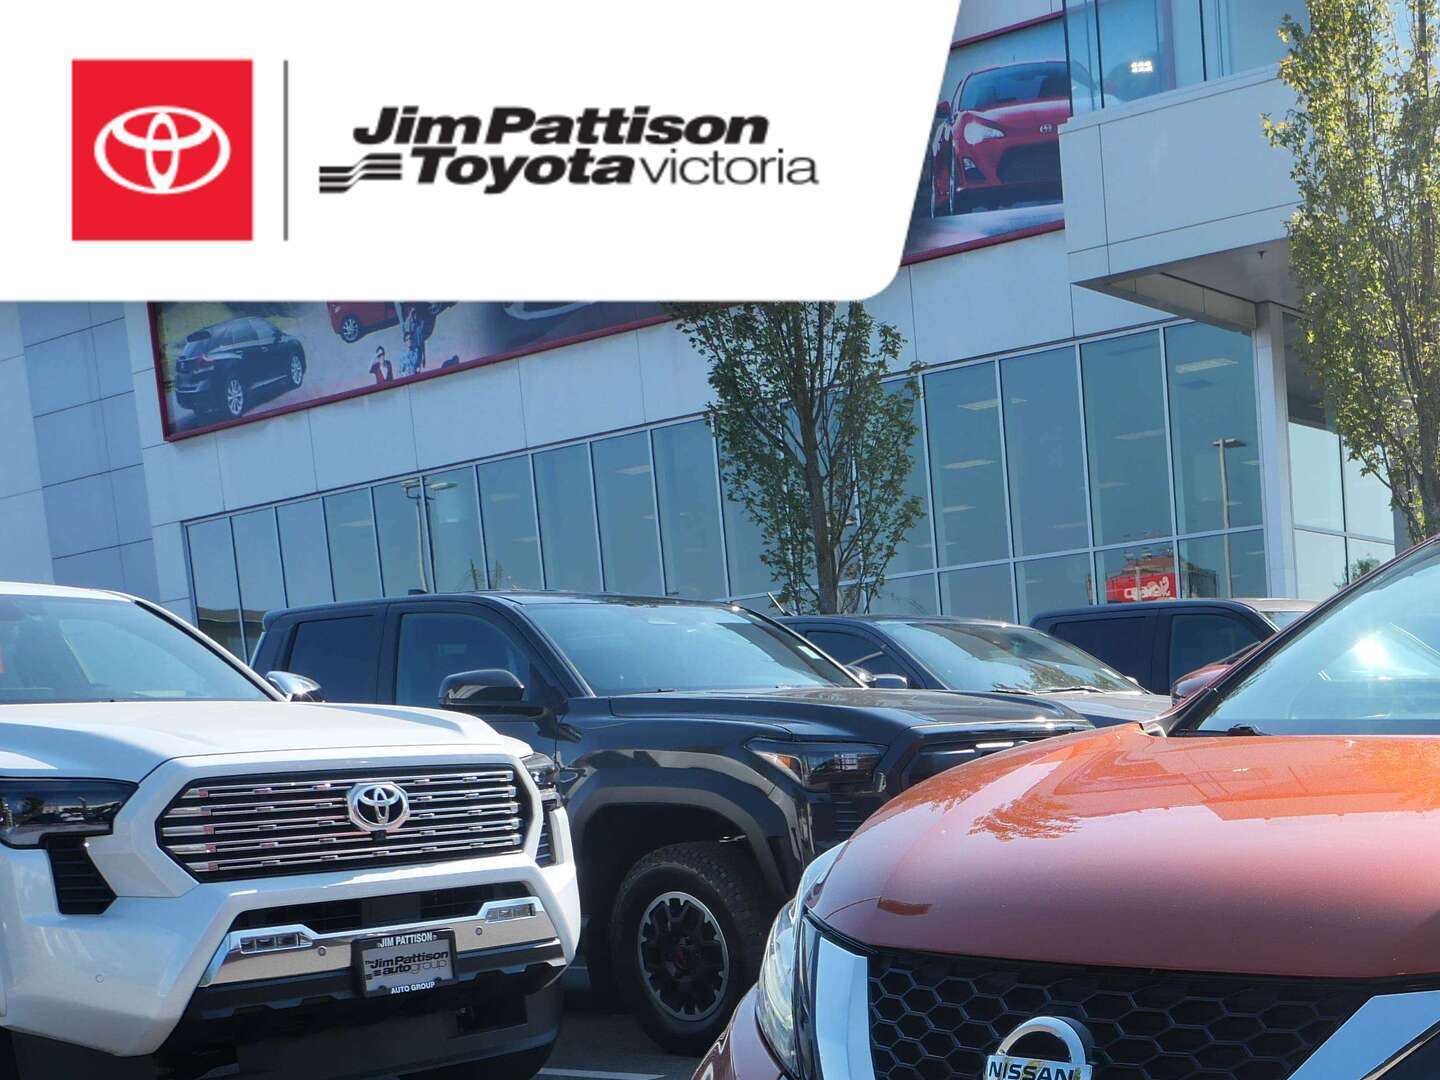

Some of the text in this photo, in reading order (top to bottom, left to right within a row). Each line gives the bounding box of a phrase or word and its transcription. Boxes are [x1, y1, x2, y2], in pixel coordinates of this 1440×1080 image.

[379, 932, 433, 948] JIM PATTISON
[391, 981, 435, 994] AUTO GROUP
